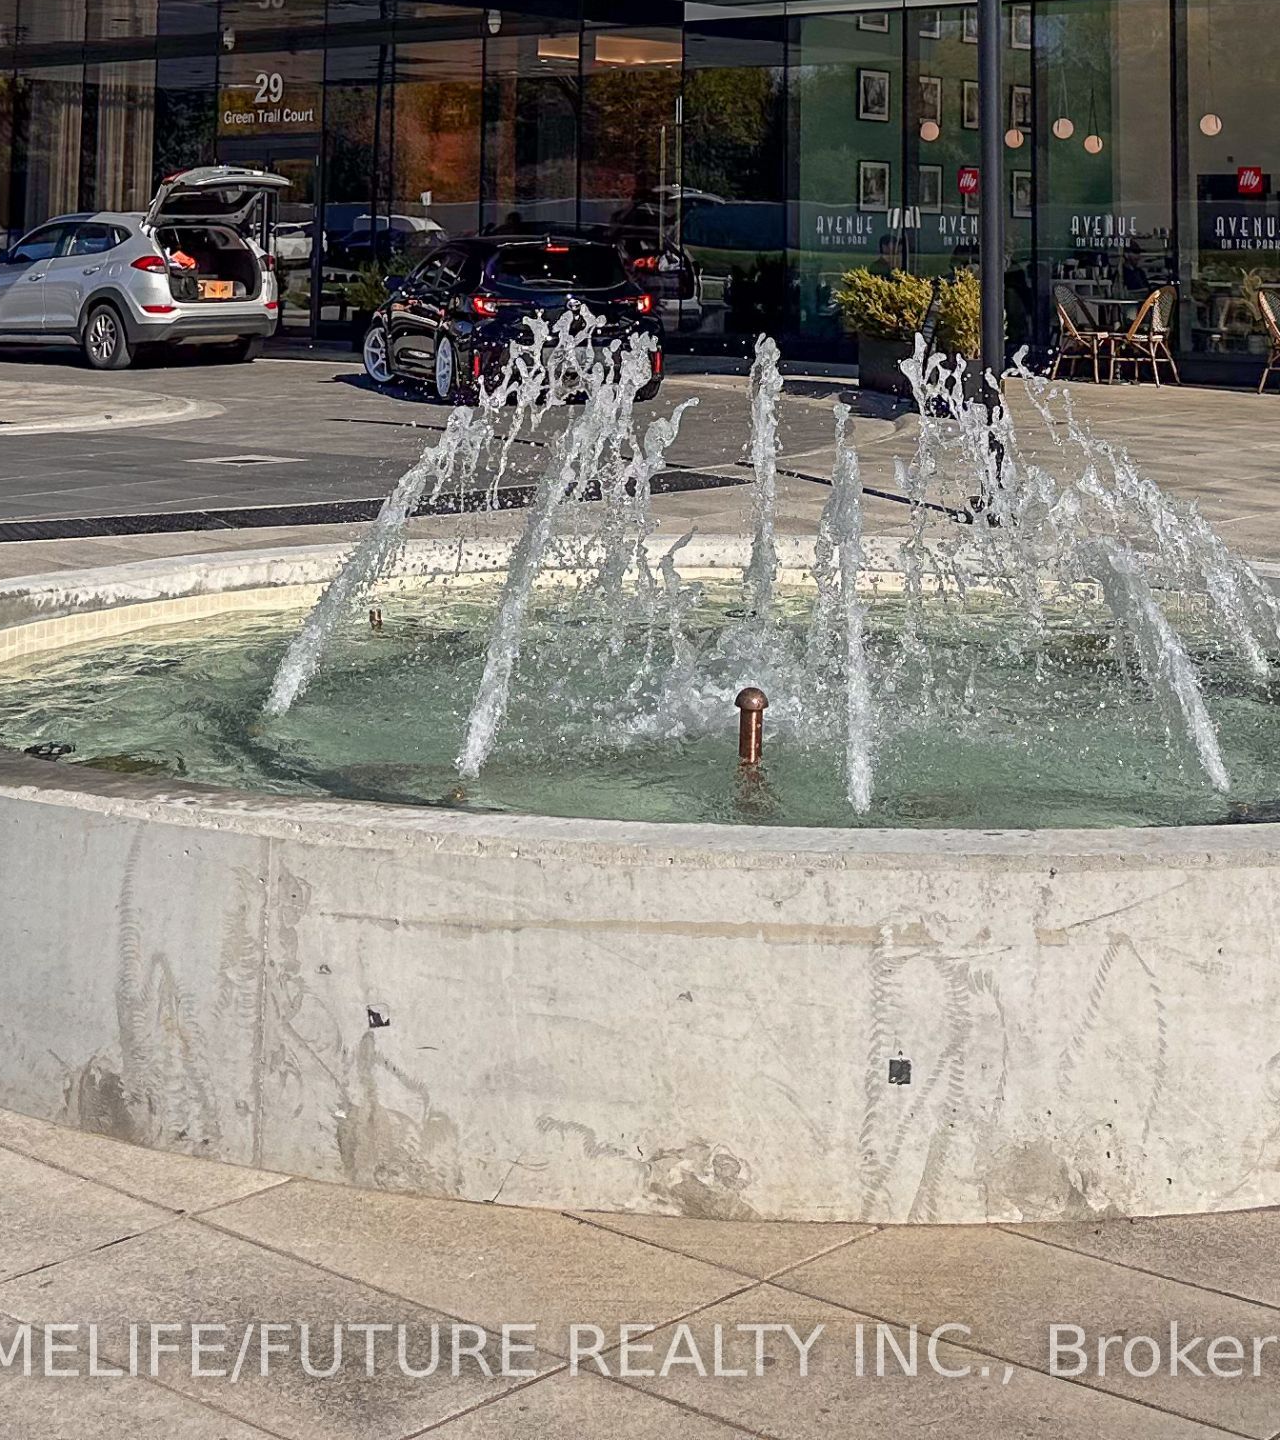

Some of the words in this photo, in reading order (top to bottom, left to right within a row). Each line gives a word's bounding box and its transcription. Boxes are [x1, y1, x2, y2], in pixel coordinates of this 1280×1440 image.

[254, 73, 283, 104] 29
[224, 110, 254, 124] Green
[258, 109, 280, 123] Trail
[283, 108, 313, 122] Court
[959, 173, 977, 190] illy
[1239, 170, 1260, 189] illy
[816, 215, 873, 235] AVENUE
[938, 215, 979, 235] AVEN
[1071, 214, 1137, 237] AVENUE
[1222, 238, 1232, 249] ON
[1235, 238, 1253, 250] THE
[1256, 238, 1280, 250] PARK
